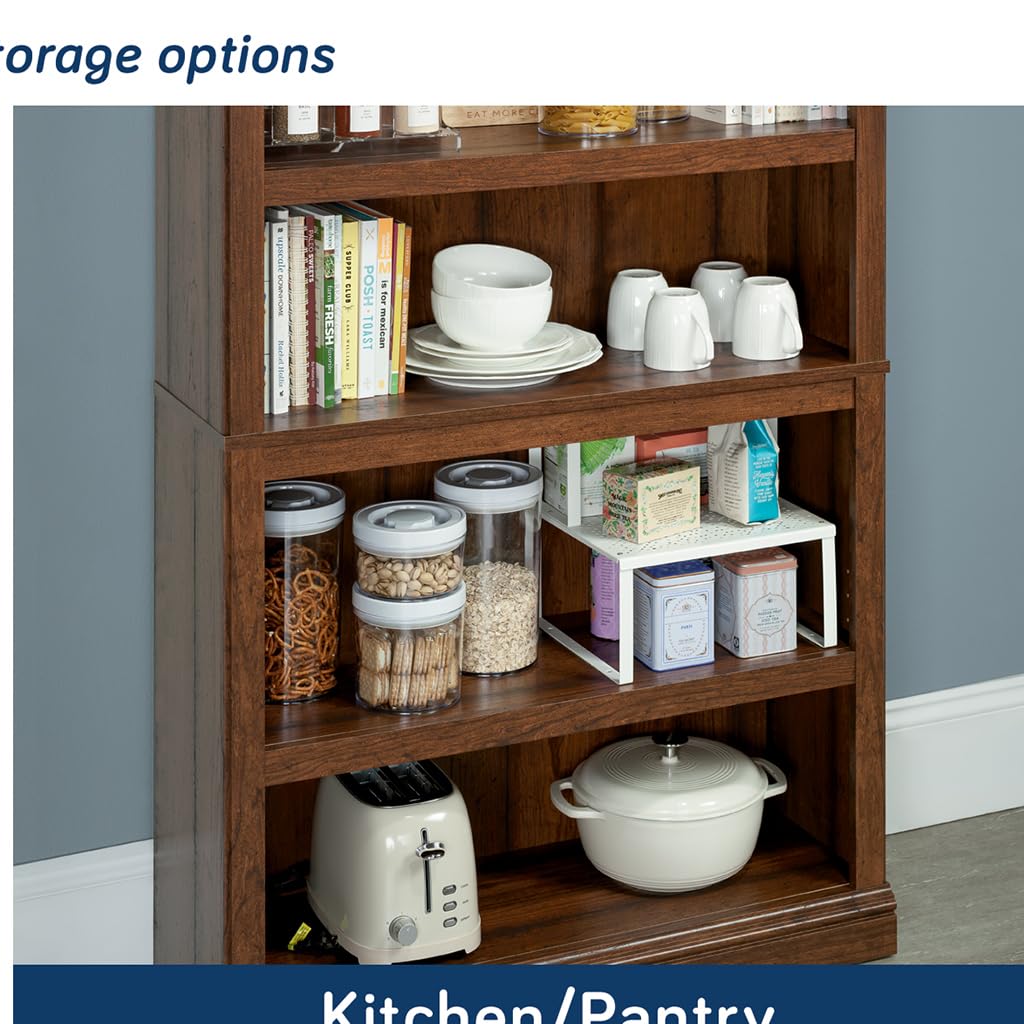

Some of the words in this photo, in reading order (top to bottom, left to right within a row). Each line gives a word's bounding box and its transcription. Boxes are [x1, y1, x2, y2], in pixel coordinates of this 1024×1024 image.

[466, 111, 490, 119] EAT
[495, 108, 525, 118] MORE
[276, 236, 284, 273] upscale
[363, 265, 374, 306] POSH
[380, 279, 388, 289] is
[380, 291, 388, 306] for
[324, 303, 334, 346] FRESH
[362, 315, 373, 350] TOAST
[379, 308, 387, 349] mexican
